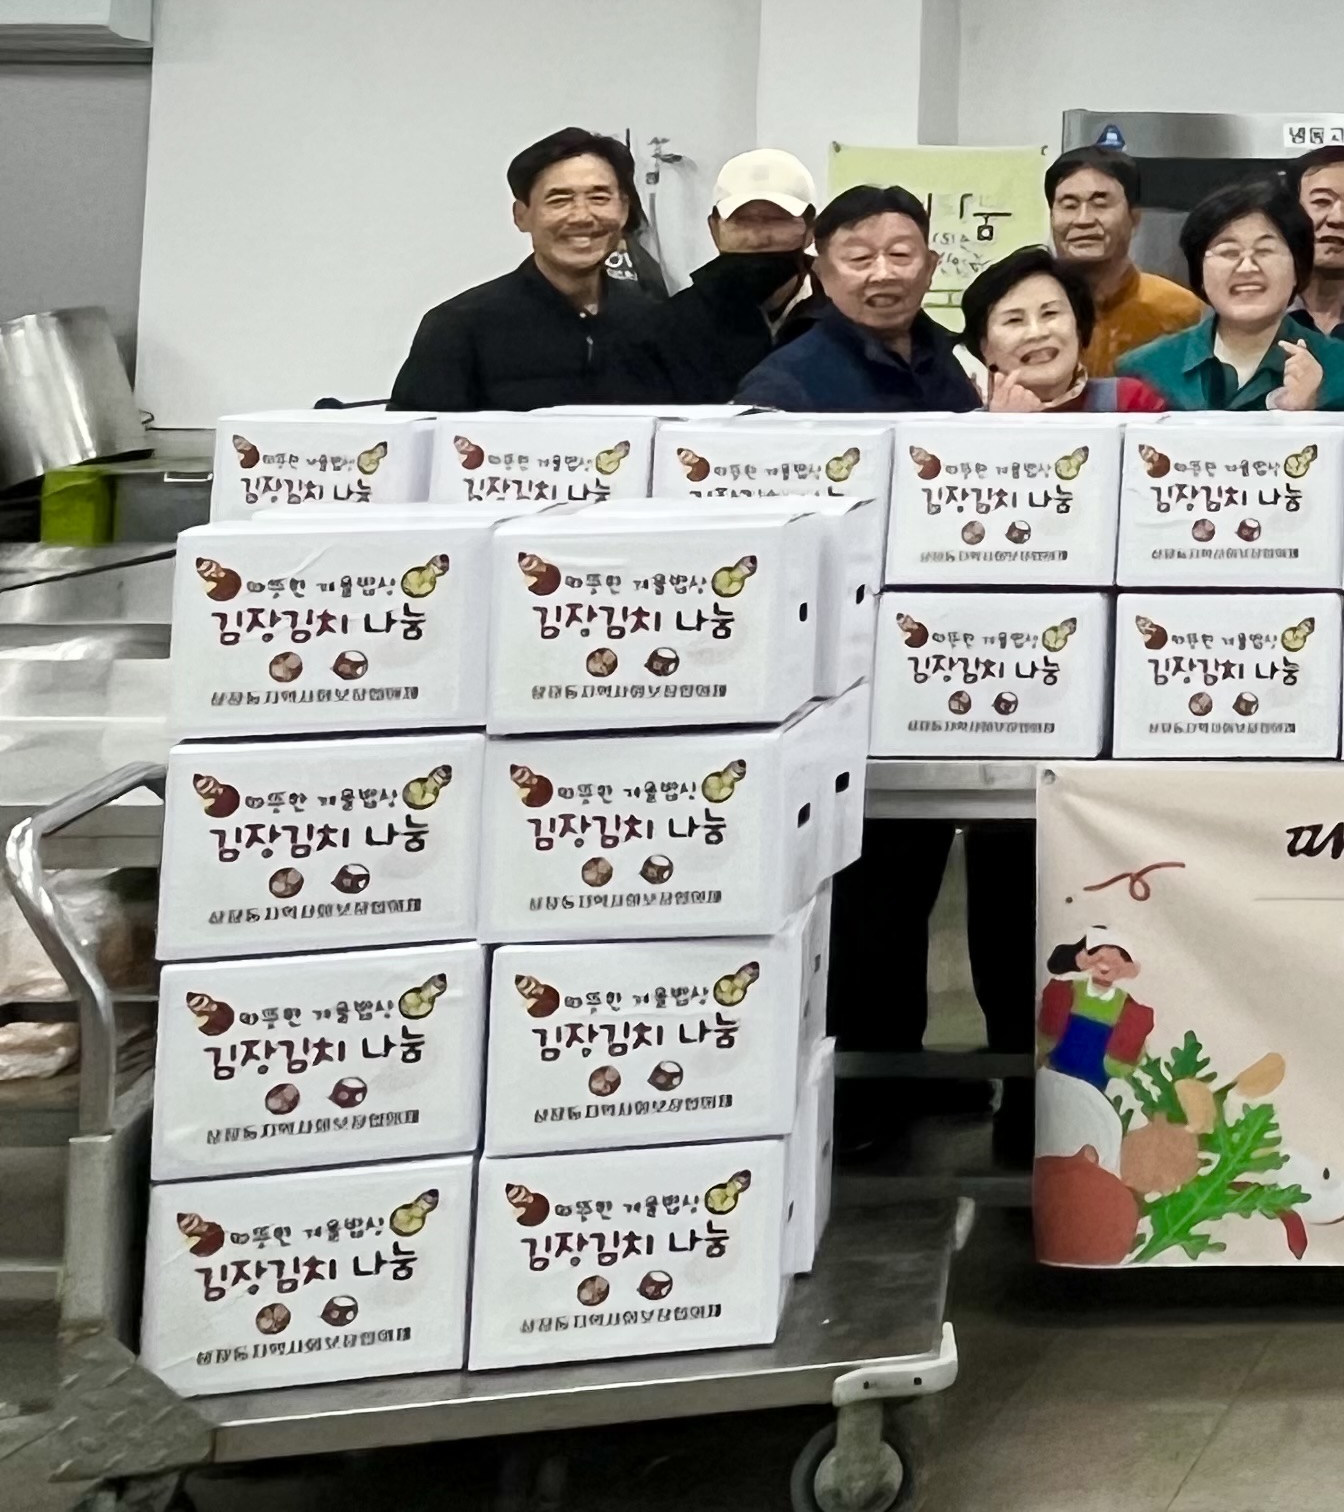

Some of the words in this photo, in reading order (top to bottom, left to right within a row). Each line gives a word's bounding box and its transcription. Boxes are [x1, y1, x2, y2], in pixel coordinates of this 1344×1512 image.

[922, 486, 1017, 515] 김장김치
[1029, 484, 1073, 514] 나눔
[1150, 483, 1247, 513] 김장김치
[1258, 483, 1303, 512] 나눔
[211, 608, 348, 646] 김장김치
[364, 603, 426, 640] 나눔
[532, 603, 661, 639] 김장김치
[676, 602, 735, 639] 나눔
[907, 654, 1004, 684] 김장김치
[1015, 655, 1060, 686] 나눔
[1148, 656, 1244, 686] 김장김치
[1255, 656, 1299, 686] 나눔
[209, 823, 349, 862] 김장김치
[365, 814, 429, 852] 나눔
[526, 814, 654, 851] 김장김치
[668, 808, 727, 845] 나눔
[203, 1037, 346, 1080] 김장김치
[362, 1025, 425, 1063] 나눔
[532, 1021, 664, 1062] 김장김치
[679, 1012, 740, 1049] 나눔
[520, 1230, 654, 1271] 김장김치
[669, 1219, 730, 1258] 나눔
[194, 1255, 337, 1302] 김장김치
[353, 1241, 418, 1281] 나눔
